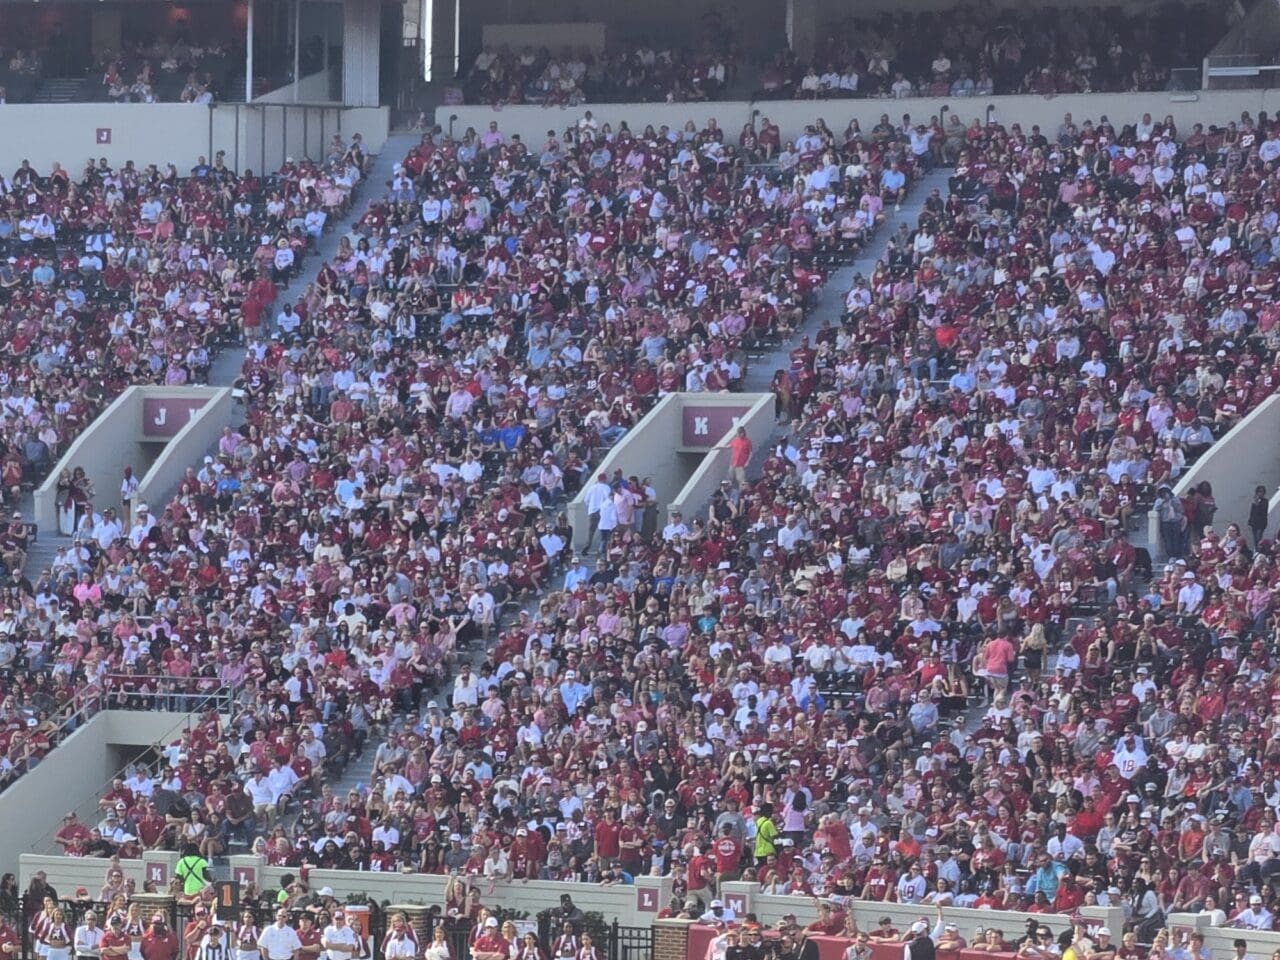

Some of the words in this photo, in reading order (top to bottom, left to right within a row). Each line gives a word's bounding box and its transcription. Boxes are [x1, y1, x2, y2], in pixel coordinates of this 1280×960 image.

[154, 408, 167, 425] J
[694, 417, 708, 434] K
[151, 868, 161, 881] K
[239, 872, 249, 886] L
[222, 884, 232, 907] 1
[643, 893, 652, 907] L
[729, 899, 742, 913] M
